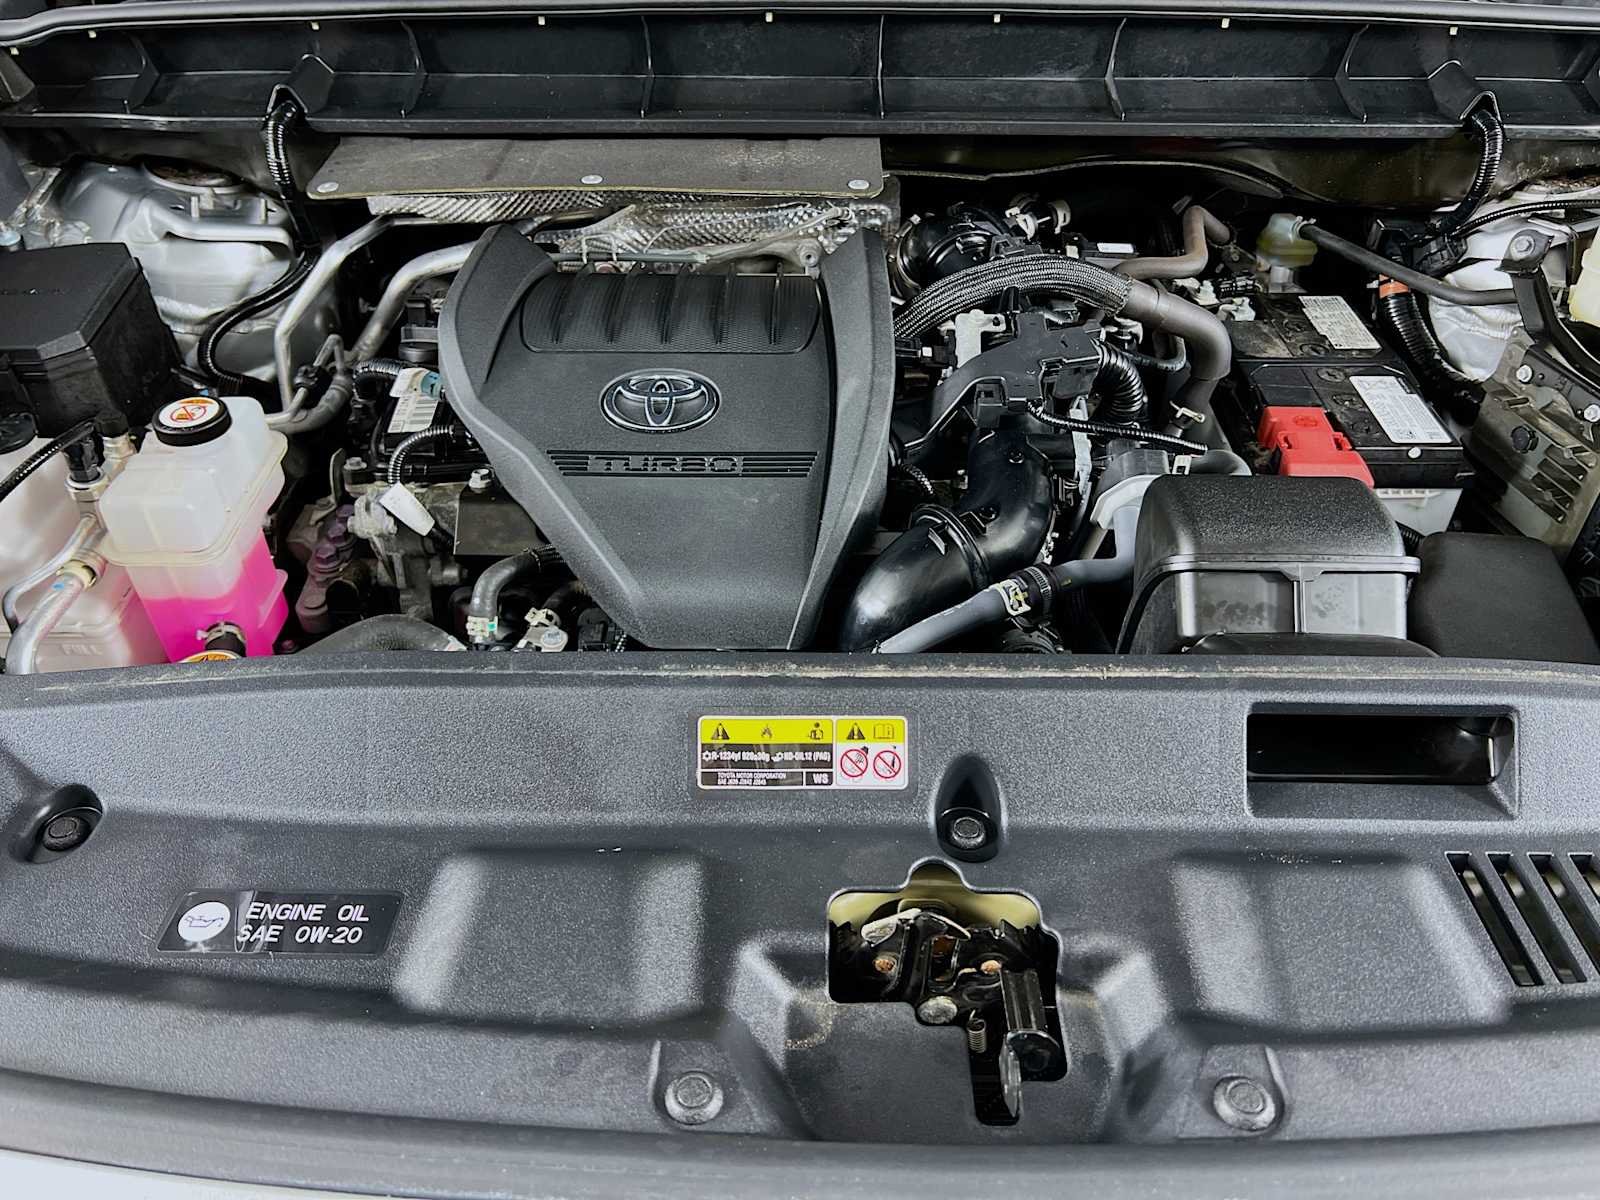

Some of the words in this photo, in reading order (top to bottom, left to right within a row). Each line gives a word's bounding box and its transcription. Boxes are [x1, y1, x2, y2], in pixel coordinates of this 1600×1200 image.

[594, 455, 738, 472] TURBO
[813, 773, 829, 784] WS
[245, 902, 326, 921] ENGINE
[337, 904, 369, 922] OIL
[237, 924, 284, 942] SAE
[295, 926, 363, 943] 0W-20
